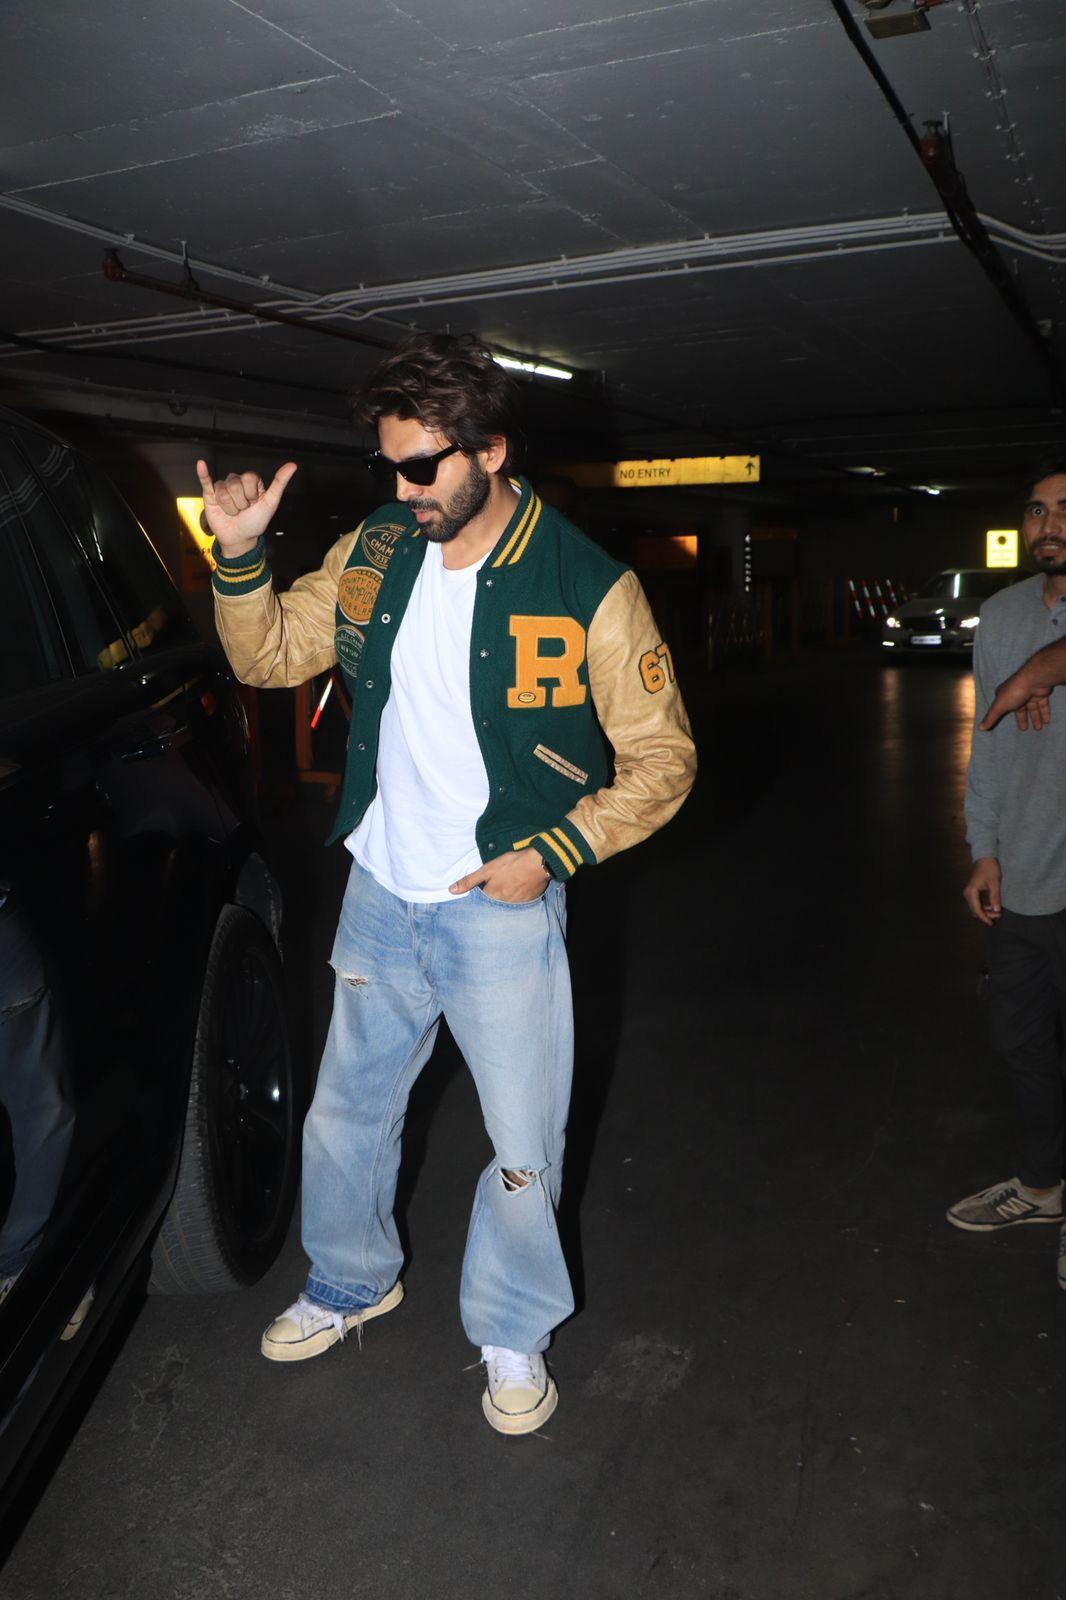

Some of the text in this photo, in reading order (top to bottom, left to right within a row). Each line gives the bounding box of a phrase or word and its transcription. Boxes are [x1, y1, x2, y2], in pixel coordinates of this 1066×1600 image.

[619, 467, 672, 480] NO ENTRY
[508, 615, 587, 708] R
[639, 640, 676, 695] 67
